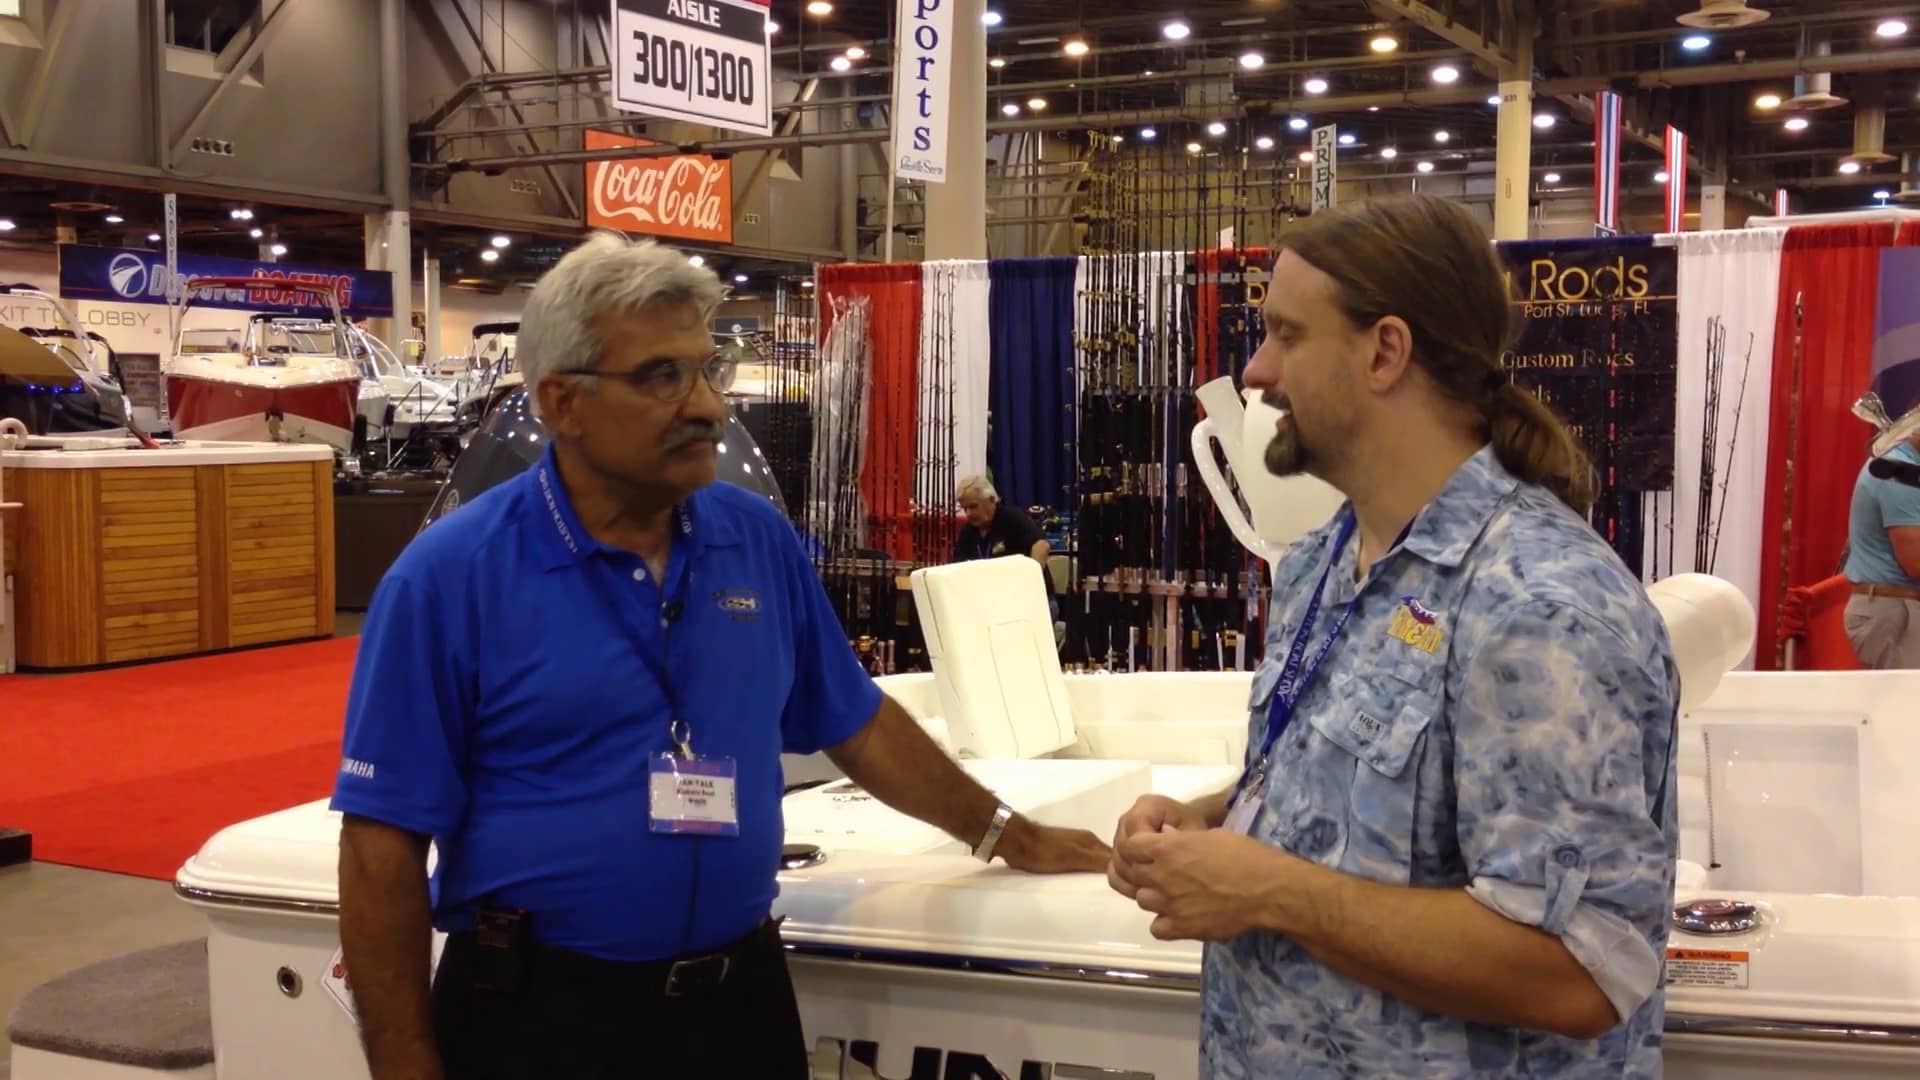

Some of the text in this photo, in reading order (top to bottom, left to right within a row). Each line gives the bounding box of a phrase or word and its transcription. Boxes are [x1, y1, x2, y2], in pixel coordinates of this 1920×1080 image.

[667, 0, 721, 28] AISLE
[632, 30, 754, 106] 300/1300
[1530, 255, 1649, 301] Rods
[1524, 304, 1552, 319] Port
[1634, 301, 1651, 315] FL
[1500, 350, 1574, 369] Custom
